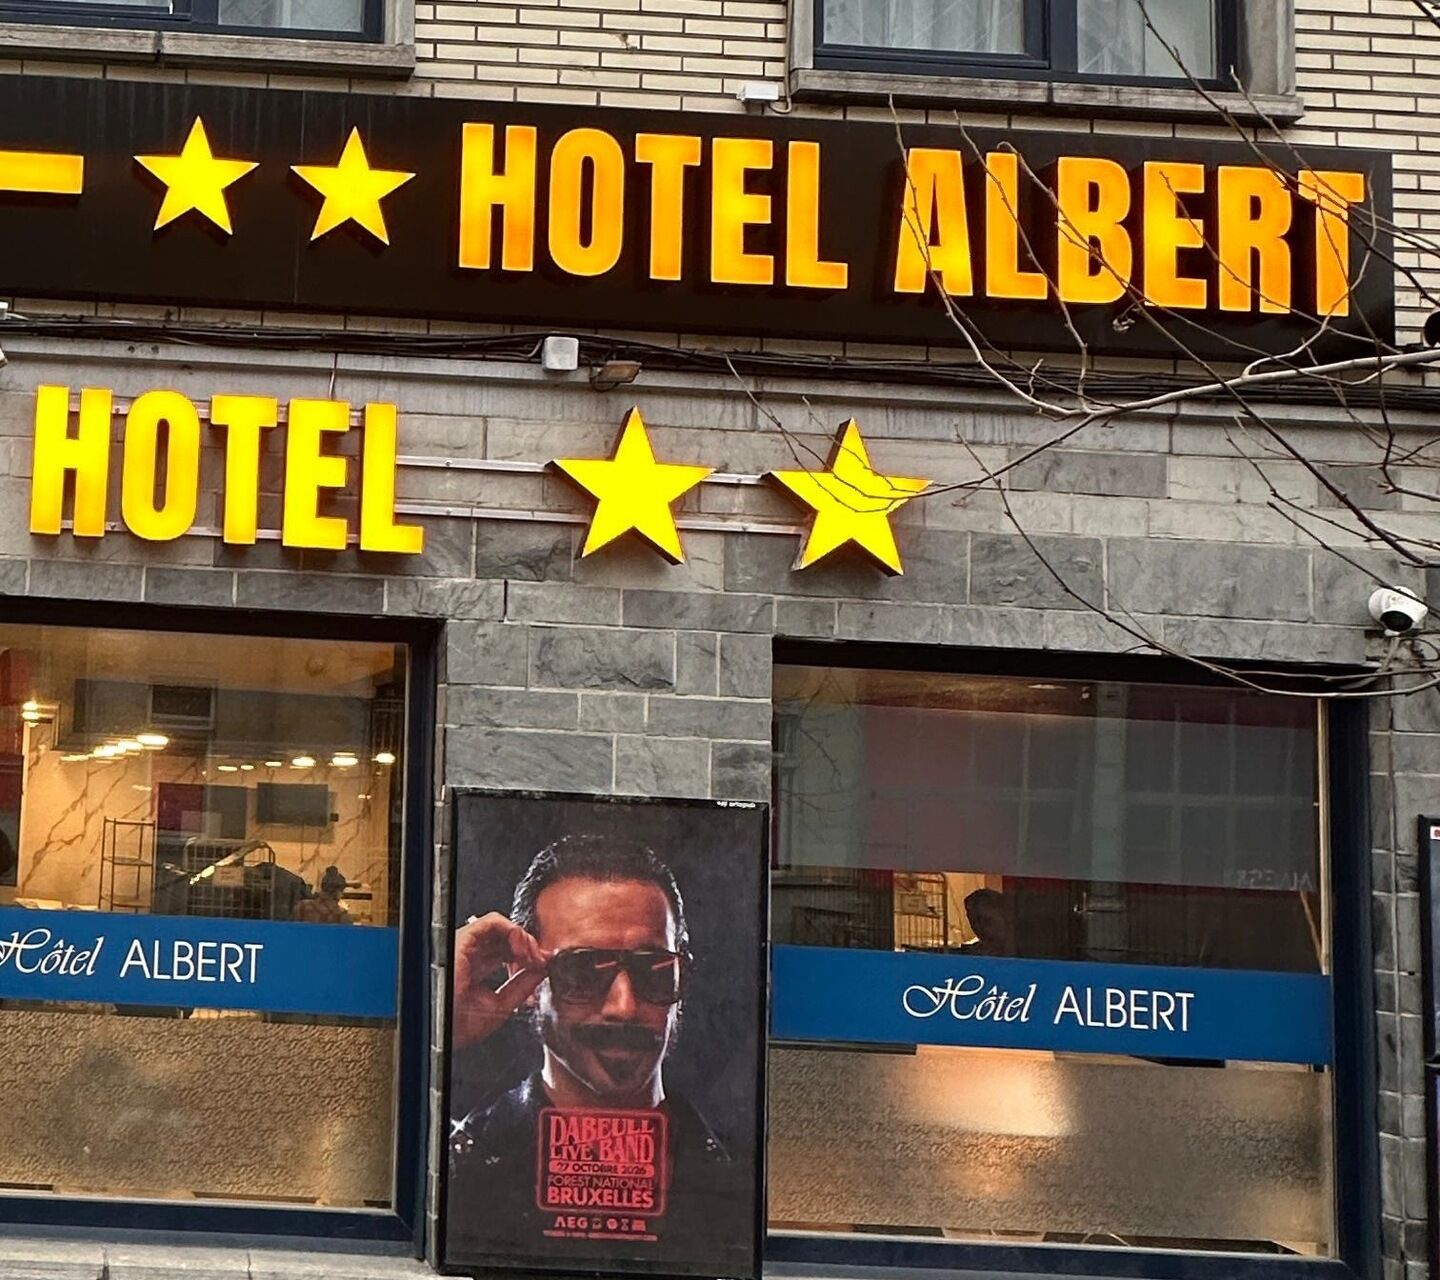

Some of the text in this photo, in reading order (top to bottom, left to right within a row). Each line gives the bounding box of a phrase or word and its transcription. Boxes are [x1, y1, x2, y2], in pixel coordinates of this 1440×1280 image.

[458, 122, 1365, 318] HOTEL ALBERT
[30, 384, 424, 554] HOTEL
[120, 938, 263, 983] ALBERT
[902, 974, 1195, 1032] Hôtel ALBERT
[550, 1115, 654, 1146] DABEULL
[550, 1134, 655, 1163] LIVE BAND
[548, 1175, 655, 1190] FOREST NATIONAL
[572, 1163, 618, 1174] OCTOBRE
[621, 1165, 647, 1175] 2026
[547, 1186, 654, 1208] BRUXELLES
